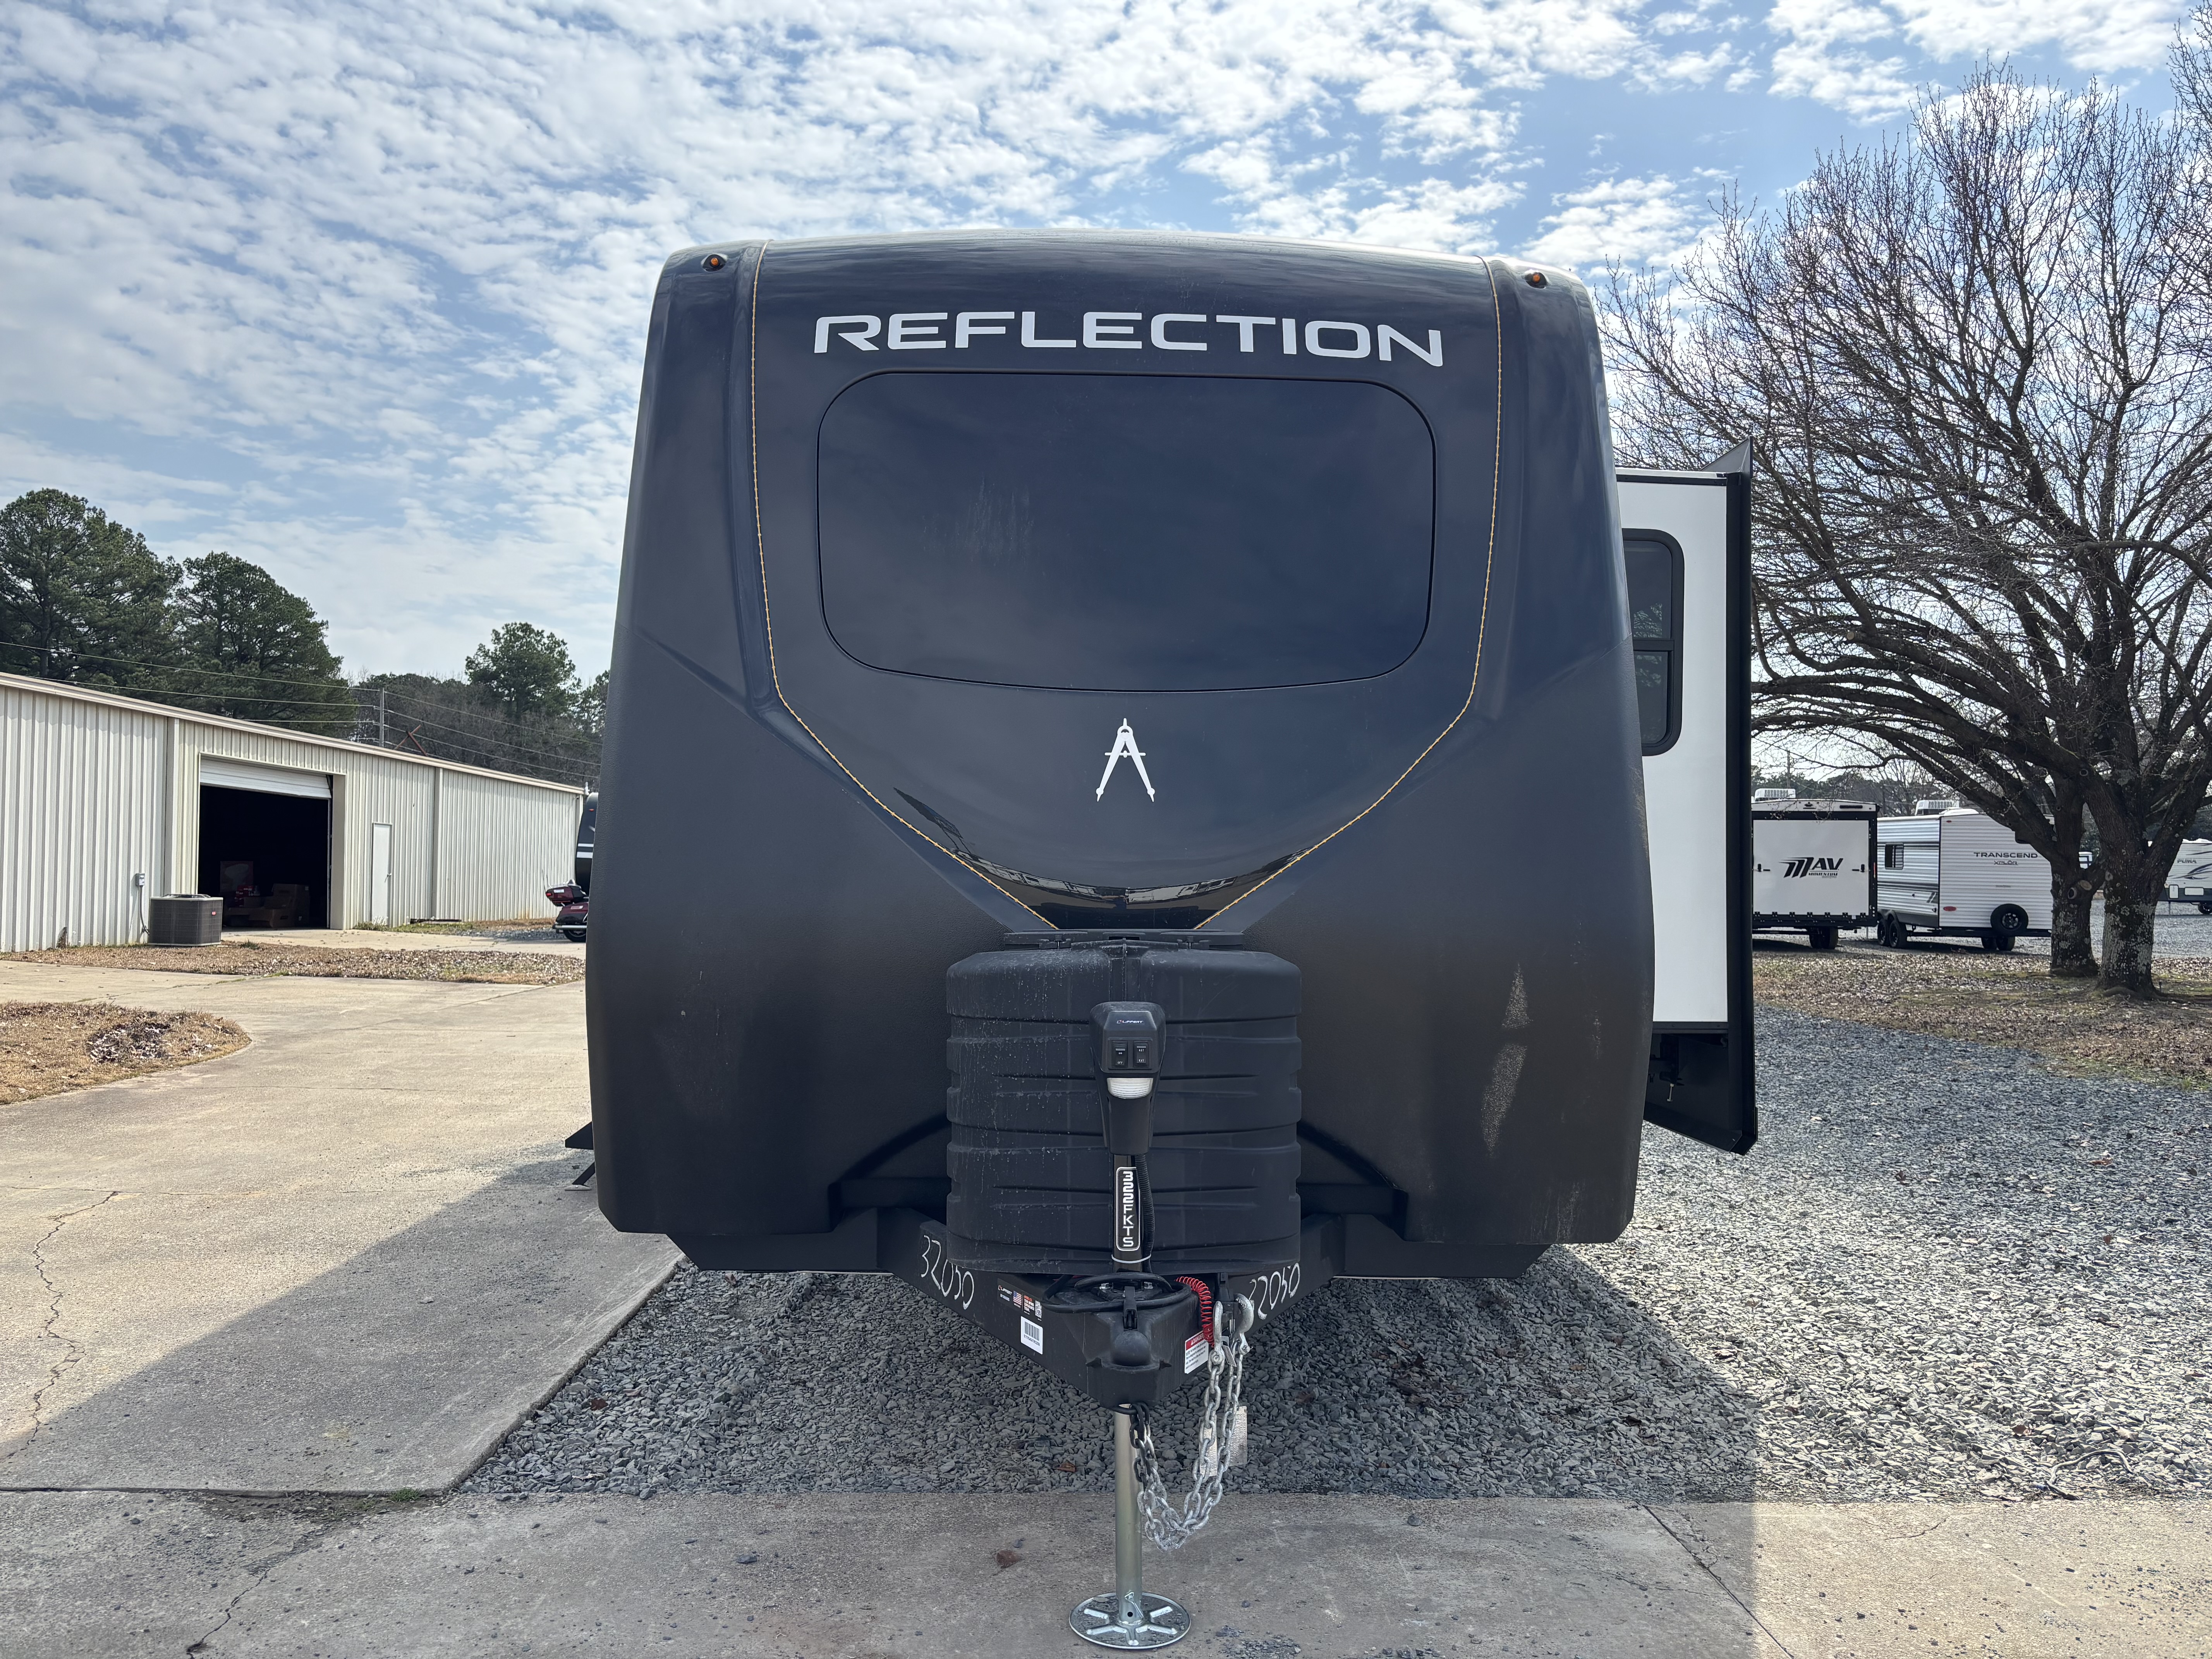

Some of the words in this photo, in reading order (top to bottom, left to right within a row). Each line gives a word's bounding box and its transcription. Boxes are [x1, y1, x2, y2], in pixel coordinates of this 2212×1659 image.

[814, 311, 1443, 367] REFLECTION
[1123, 1171, 1134, 1247] 322FKTS
[921, 1235, 974, 1310] 32050
